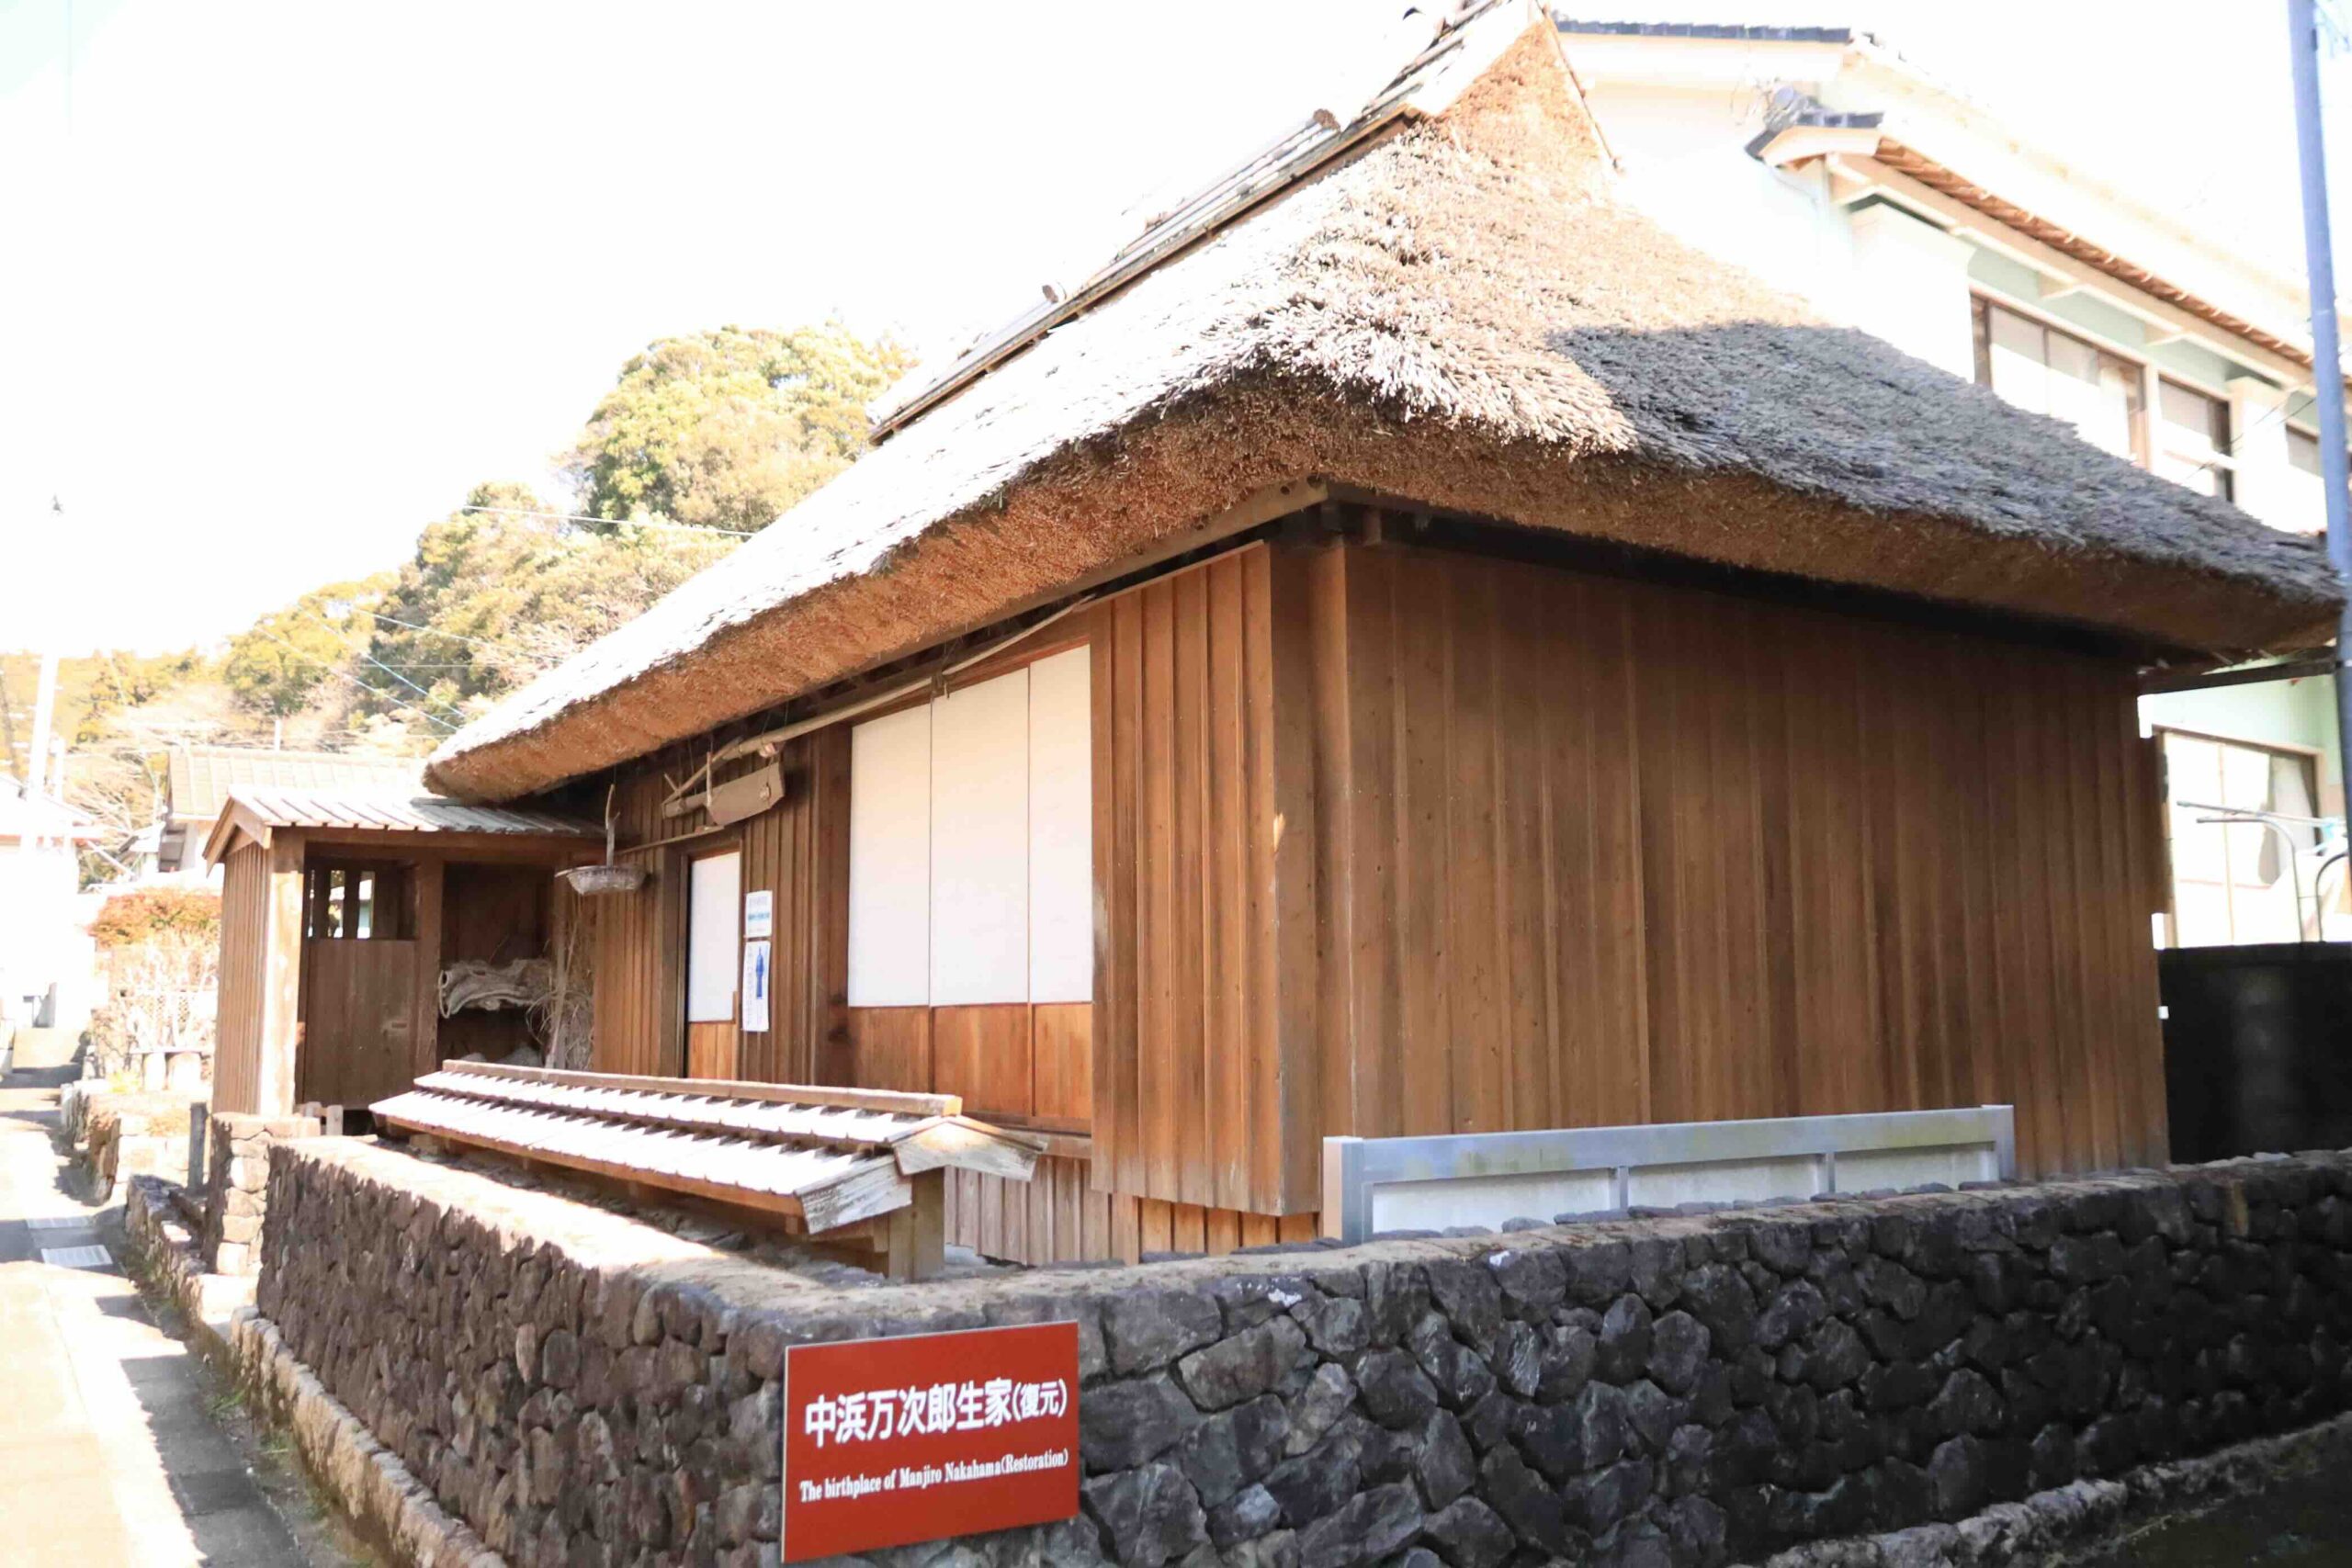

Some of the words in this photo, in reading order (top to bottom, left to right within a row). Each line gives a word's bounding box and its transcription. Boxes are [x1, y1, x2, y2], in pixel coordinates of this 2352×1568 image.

[805, 1378, 1068, 1448] 中浜万次郎生家(復元)
[799, 1480, 823, 1503] The
[824, 1473, 882, 1499] birthplace
[884, 1469, 897, 1490] of
[899, 1464, 943, 1489] Manjiro
